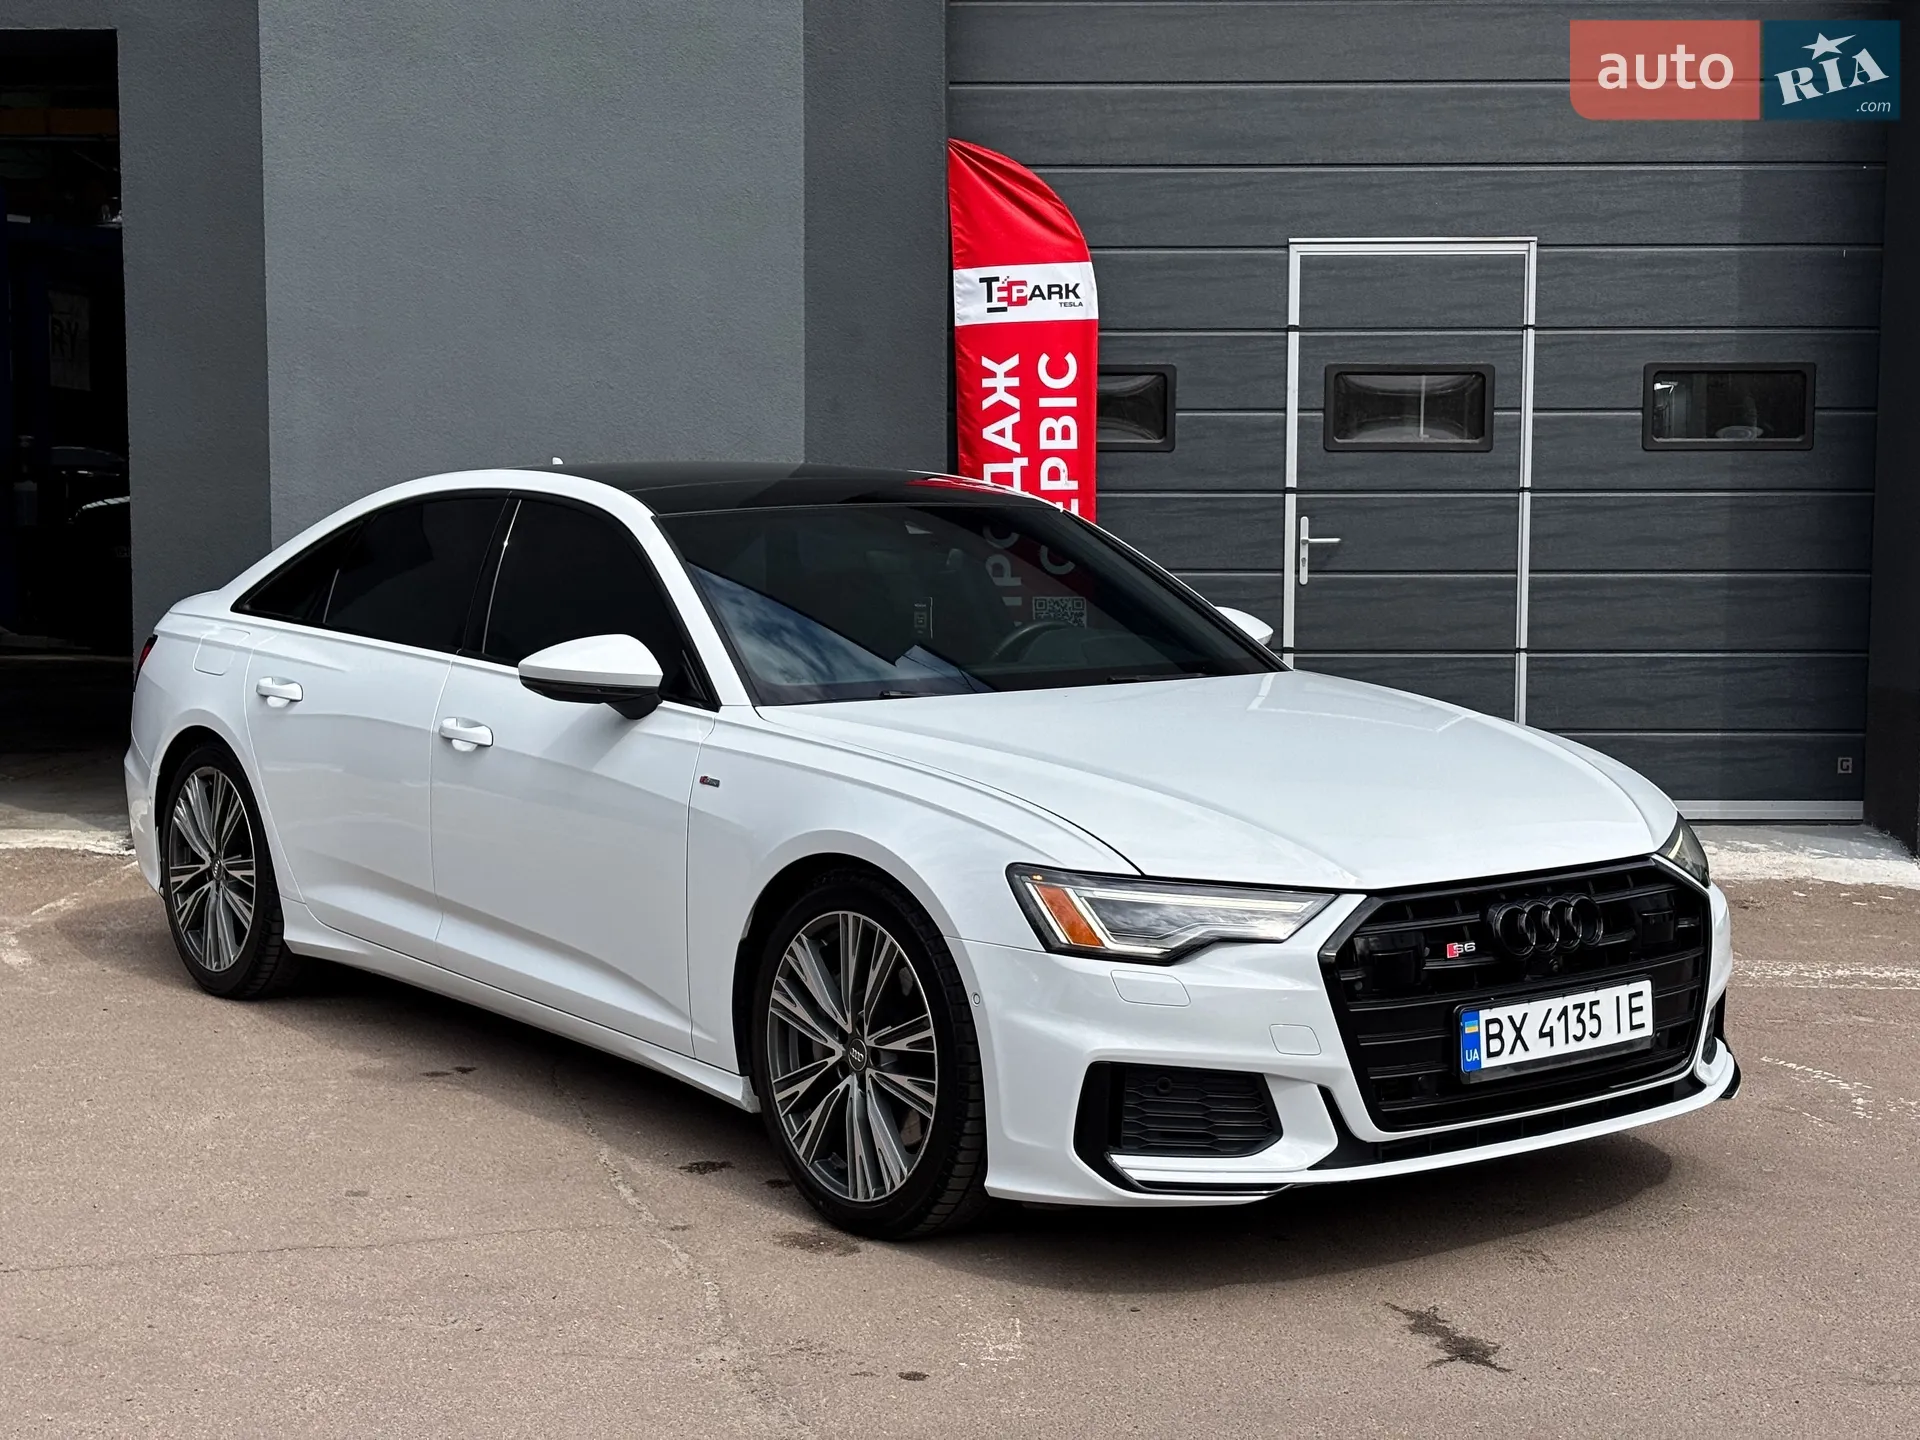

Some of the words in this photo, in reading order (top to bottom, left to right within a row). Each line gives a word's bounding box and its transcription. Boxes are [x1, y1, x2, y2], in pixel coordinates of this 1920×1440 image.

[1453, 942, 1476, 955] S6
[1485, 1012, 1530, 1059] BX
[1538, 1000, 1602, 1048] 4135
[1616, 991, 1646, 1035] IE
[1465, 1049, 1480, 1062] UA
